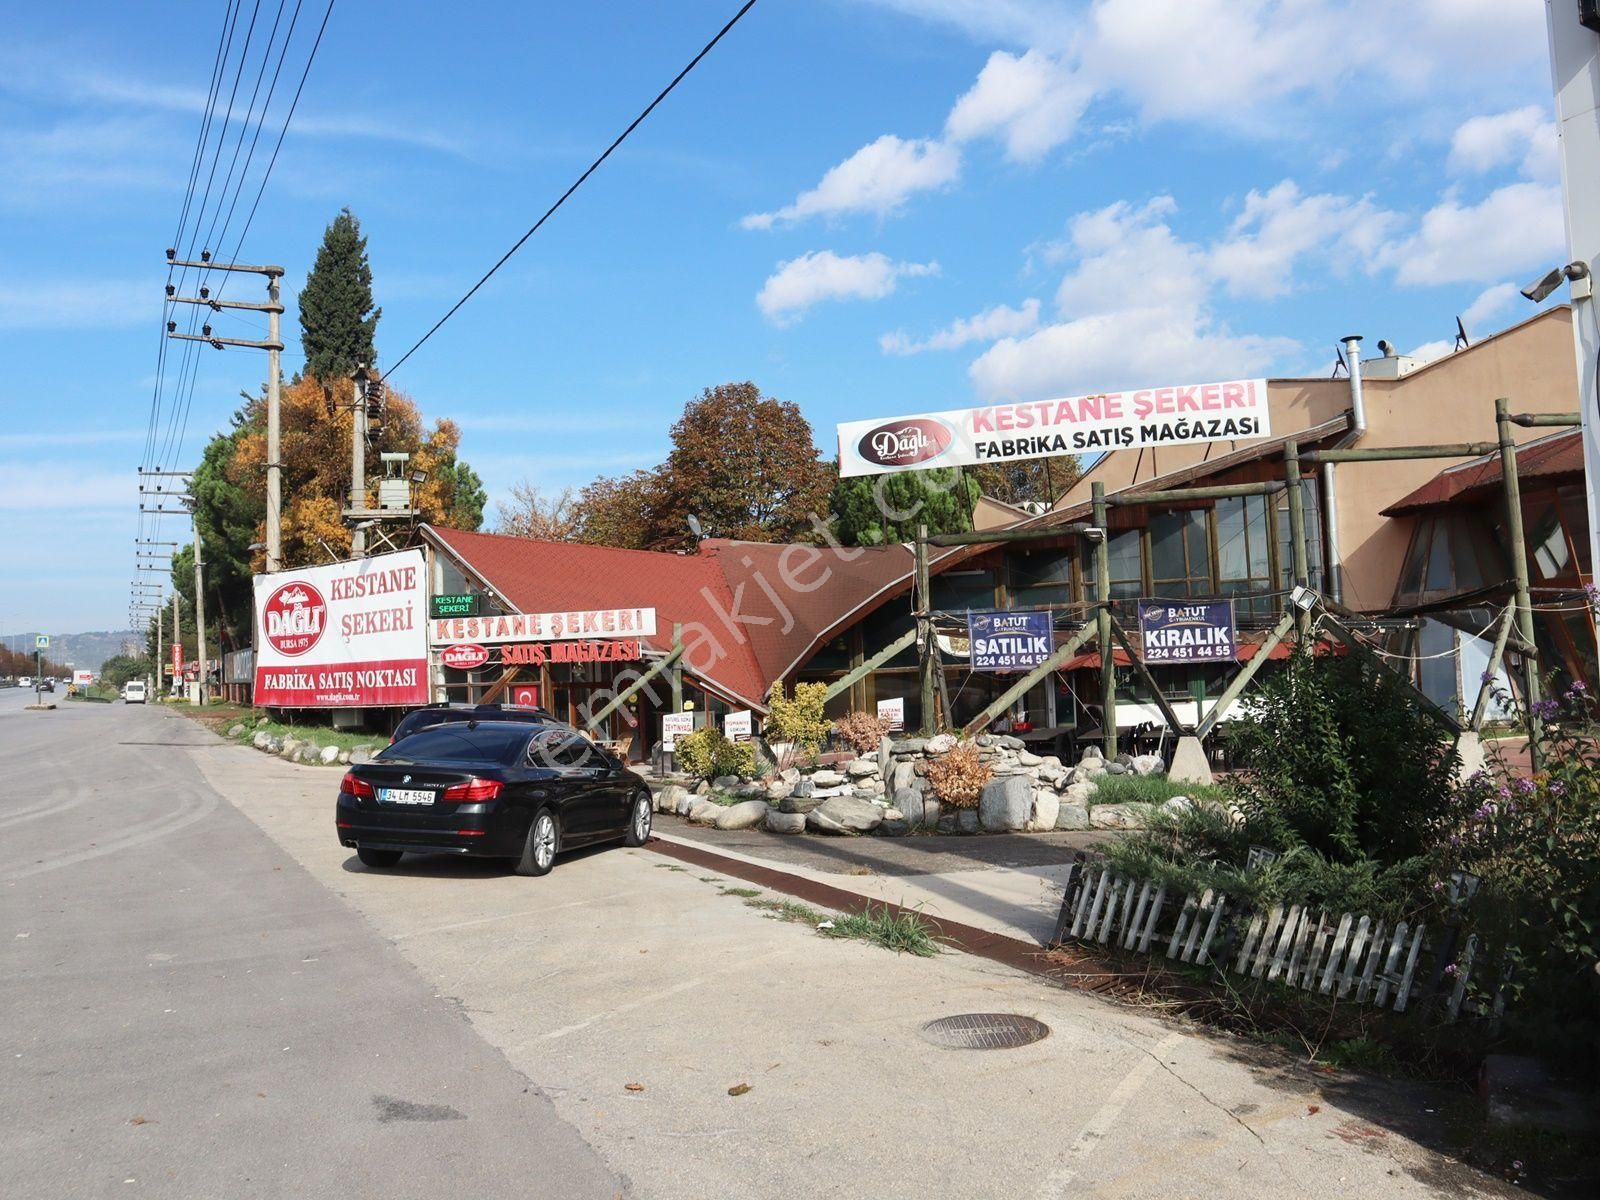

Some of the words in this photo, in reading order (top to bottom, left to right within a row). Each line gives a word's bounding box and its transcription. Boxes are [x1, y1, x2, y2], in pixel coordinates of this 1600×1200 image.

[972, 394, 1123, 433] KESTANE
[1072, 426, 1134, 447] SATIŞ
[331, 566, 416, 600] KESTANE
[435, 595, 473, 604] KESTANE
[439, 604, 470, 614] ŞEKERİ
[267, 603, 321, 637] DAĞLI
[1168, 605, 1206, 617] BATUT
[341, 600, 414, 643] ŞEKERİ
[436, 615, 542, 639] KESTANE
[993, 616, 1028, 627] BATUT
[280, 638, 297, 649] BURSA
[501, 643, 545, 666] SATIŞ
[551, 639, 640, 662] MAĞAZASI
[975, 636, 1048, 655] SATILIK
[1147, 648, 1169, 658] 224
[1172, 647, 1193, 658] 451
[1197, 646, 1212, 656] 44
[1215, 645, 1230, 655] 55
[976, 656, 995, 666] 224
[998, 655, 1016, 665] 451
[1020, 655, 1033, 664] 44
[264, 668, 316, 690] FABRİKA
[319, 671, 353, 692] SATIŞ
[356, 668, 417, 688] NOKTASI
[387, 790, 396, 800] 34
[399, 791, 409, 801] LM
[412, 791, 433, 802] 5546
